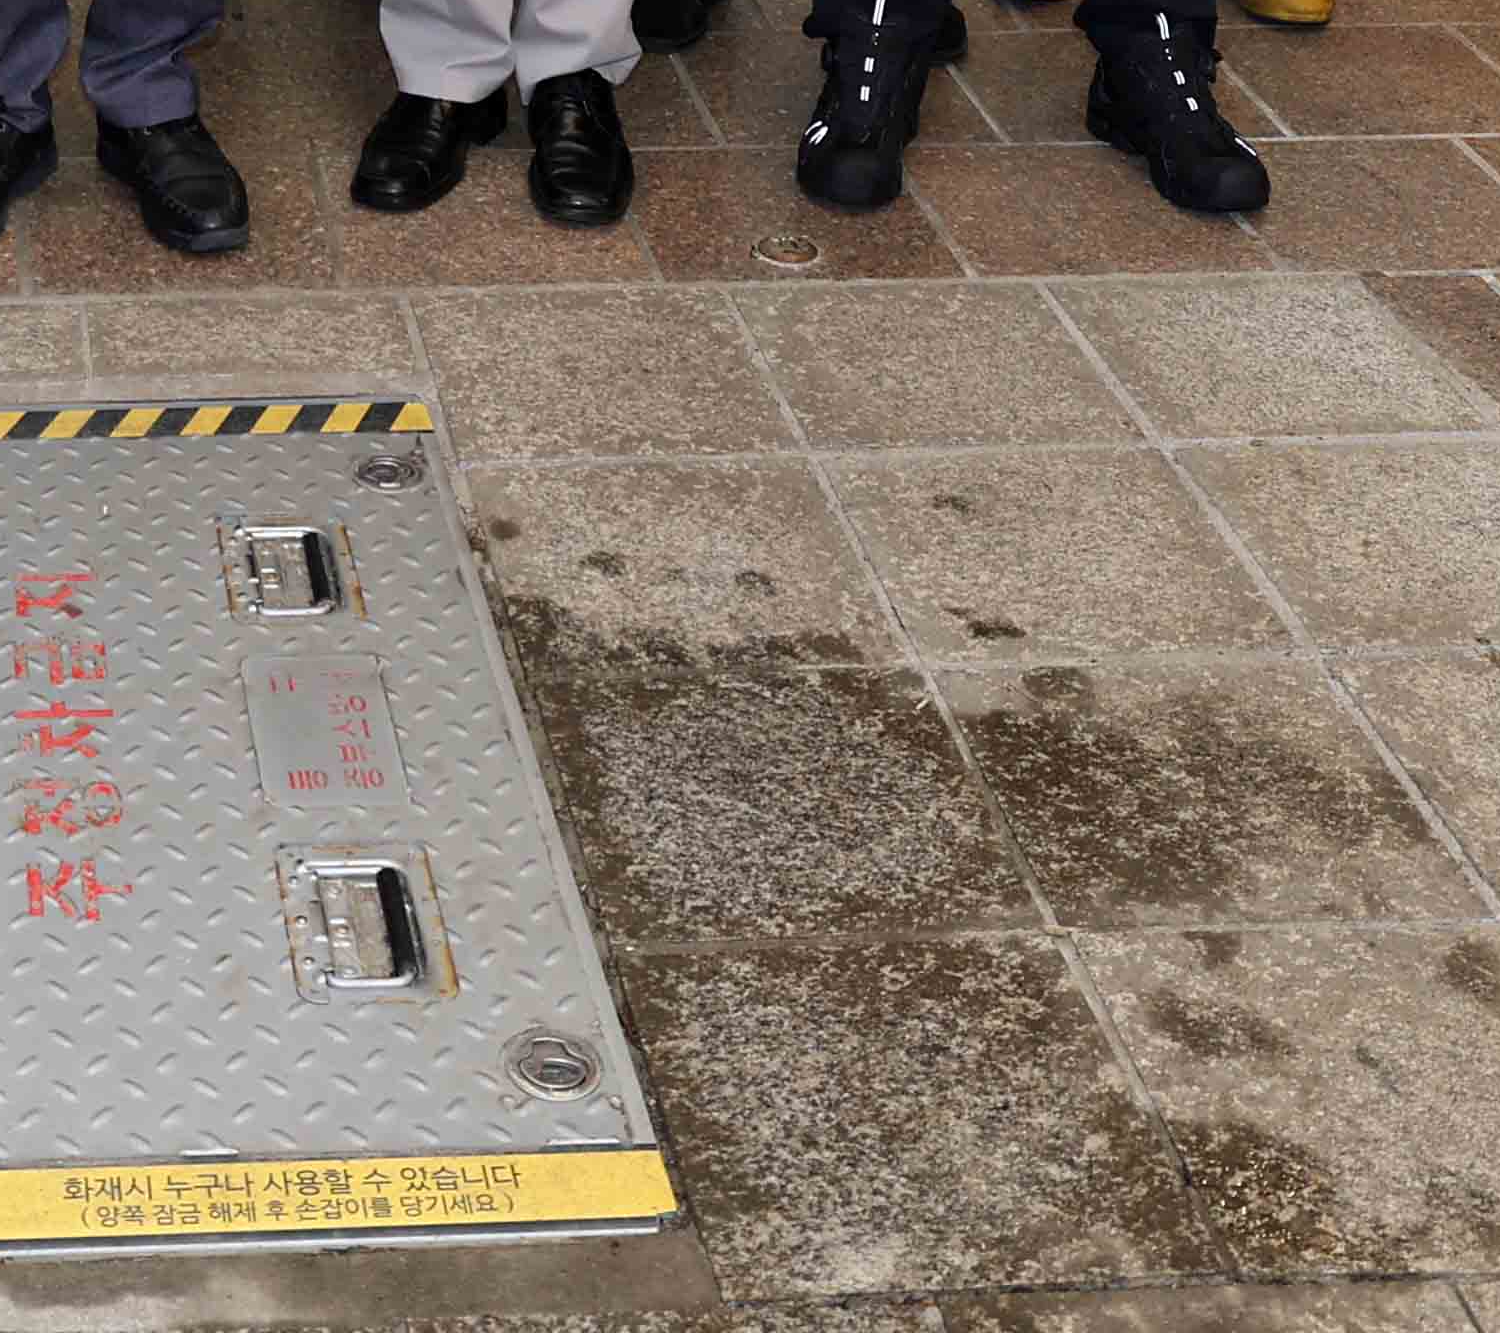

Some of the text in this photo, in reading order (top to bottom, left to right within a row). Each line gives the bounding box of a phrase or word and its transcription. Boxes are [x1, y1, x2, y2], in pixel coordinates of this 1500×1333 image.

[13, 572, 134, 922] 주정차금지
[62, 1164, 522, 1202] 화재시 누구나 사용할 수 있습니다
[152, 1195, 393, 1226] 잠금 해제 후 손잡이를
